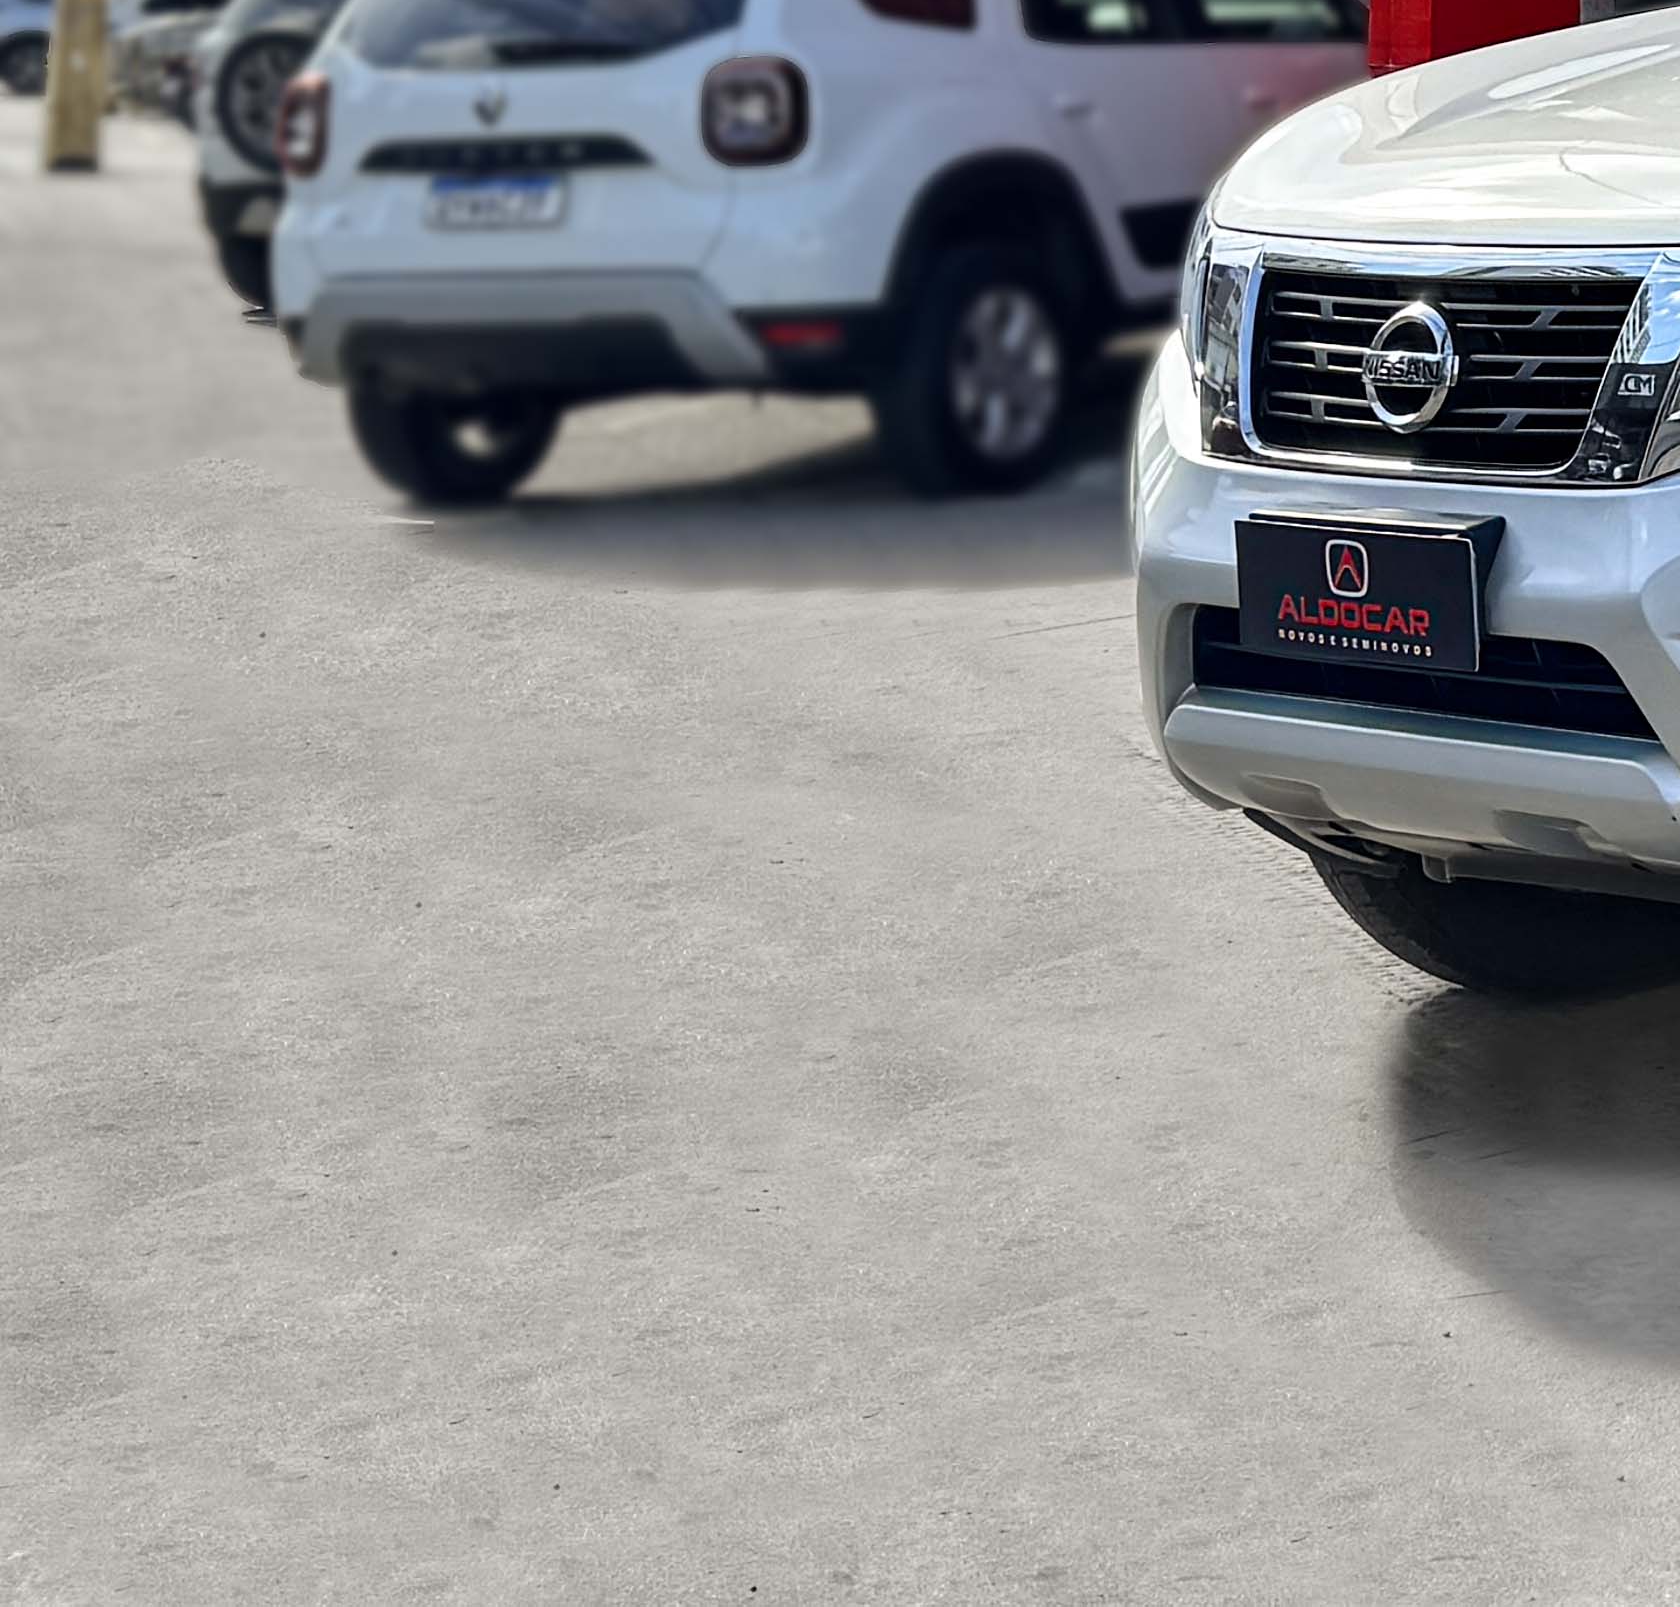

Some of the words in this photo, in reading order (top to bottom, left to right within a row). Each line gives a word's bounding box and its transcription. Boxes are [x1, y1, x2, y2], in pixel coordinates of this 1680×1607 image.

[1365, 357, 1441, 380] NISSAN
[1277, 593, 1431, 637] ALDOCAR
[1277, 628, 1325, 645] NOVOS
[1341, 636, 1433, 658] SEMINOVOS
